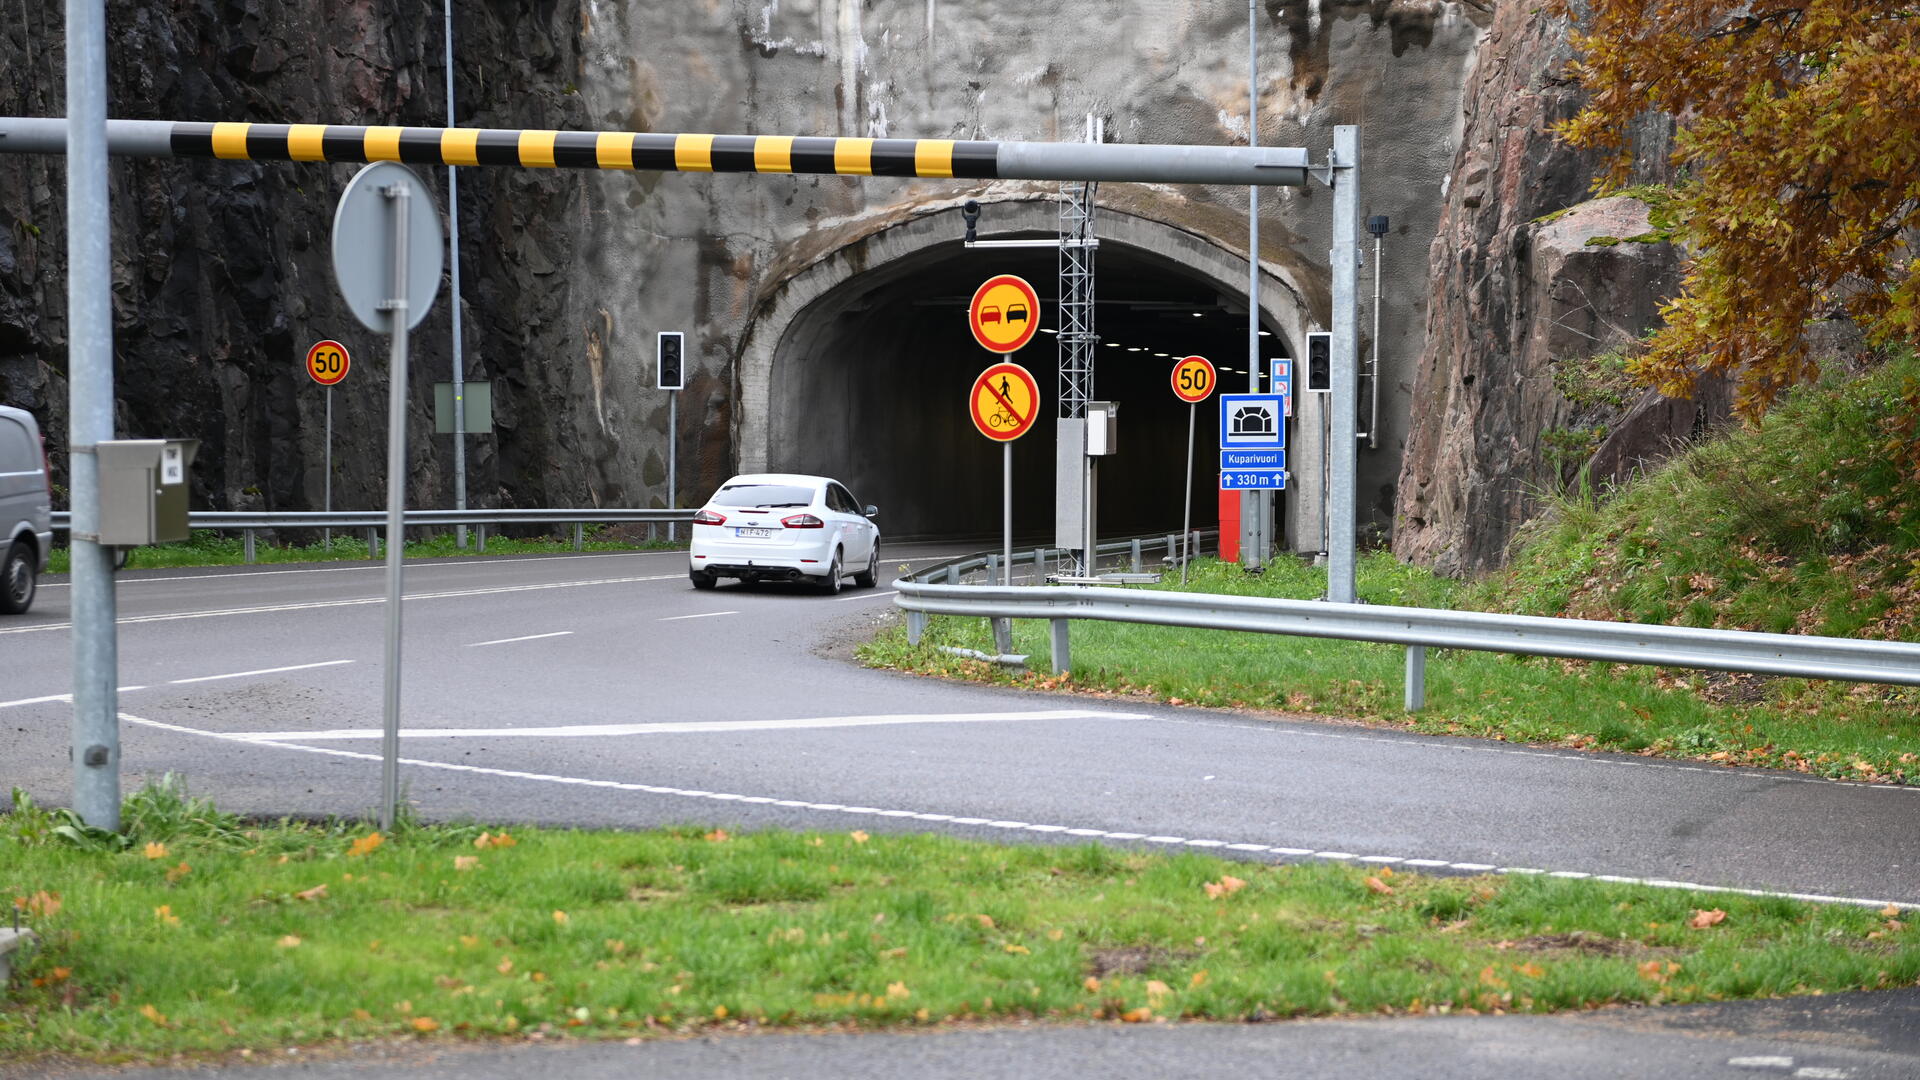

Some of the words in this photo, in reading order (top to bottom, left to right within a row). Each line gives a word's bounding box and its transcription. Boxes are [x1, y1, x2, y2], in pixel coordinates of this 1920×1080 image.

[315, 352, 340, 373] 50
[1180, 368, 1206, 390] 50
[1228, 453, 1278, 465] Kuparivuori
[1237, 474, 1257, 486] 330
[1259, 476, 1269, 485] m
